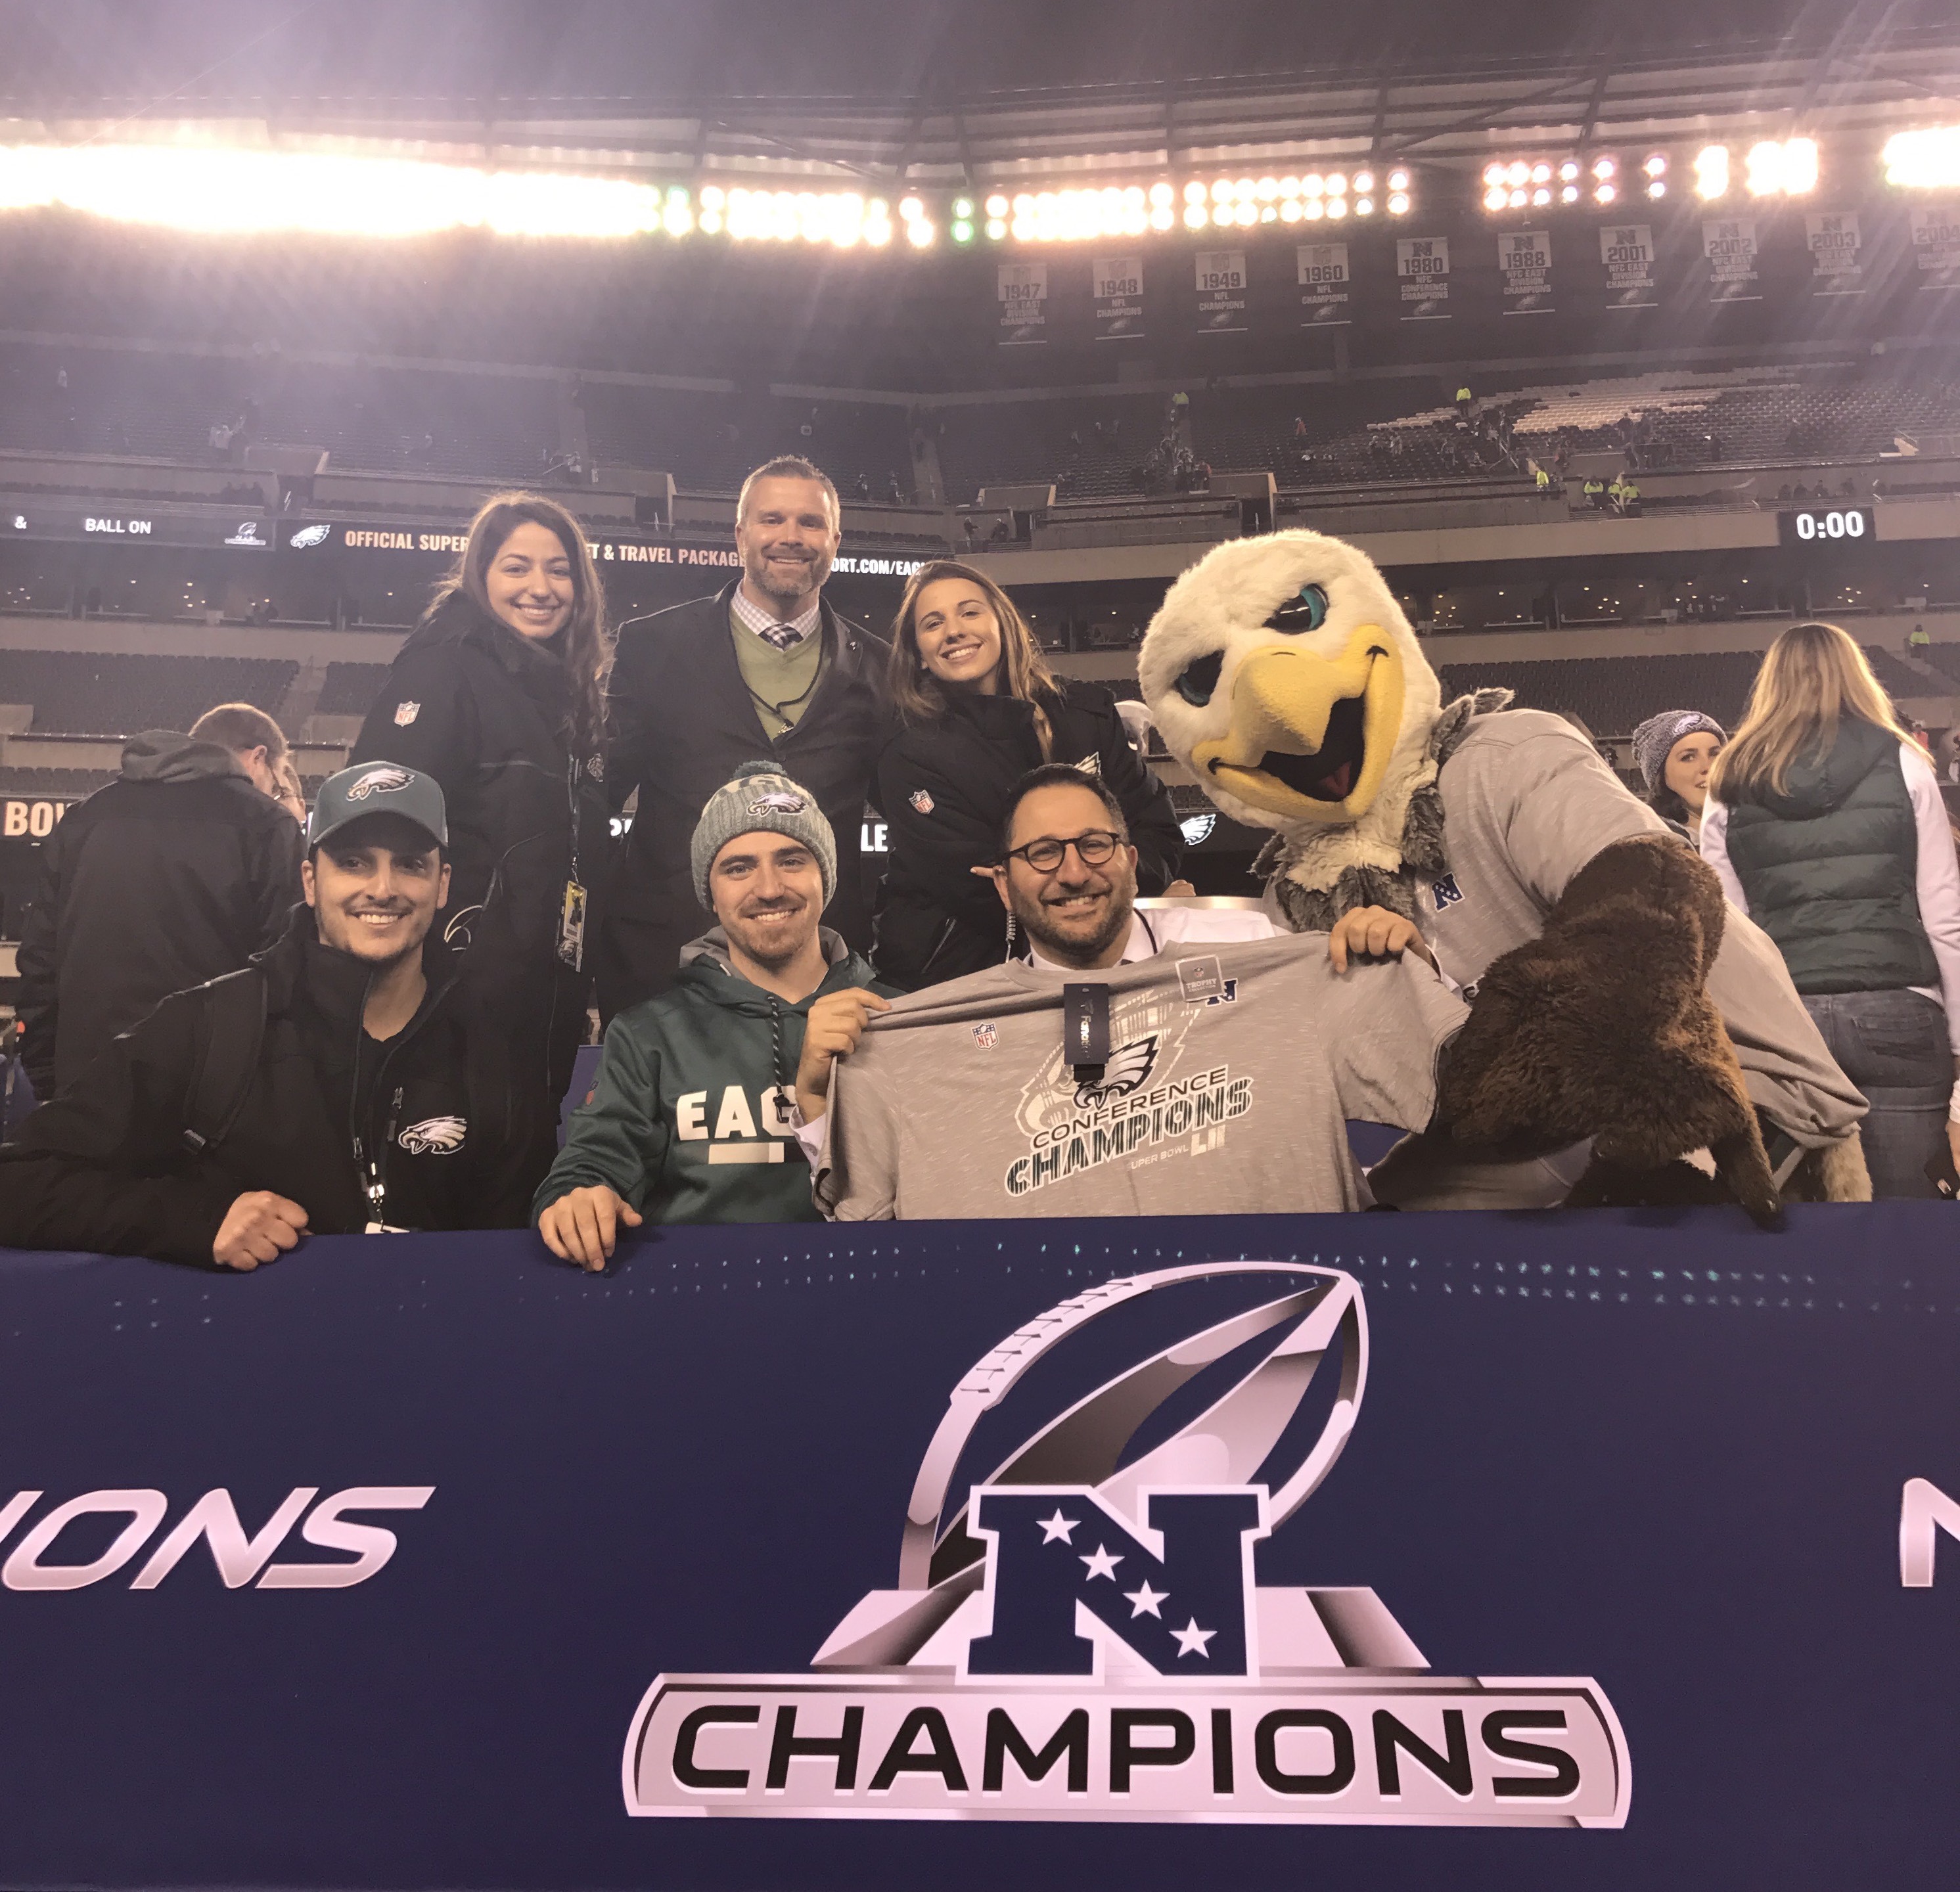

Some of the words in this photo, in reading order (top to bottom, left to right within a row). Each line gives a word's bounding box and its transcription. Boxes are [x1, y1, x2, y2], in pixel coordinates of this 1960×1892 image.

[1709, 238, 1752, 256] 2002
[1812, 231, 1856, 250] 2003
[1505, 251, 1545, 269] 1988
[1607, 245, 1647, 262] 2001
[1304, 265, 1343, 282] 1960
[1403, 258, 1443, 274] 1980
[1609, 263, 1626, 273] NFC
[1628, 262, 1649, 272] EAST
[1099, 279, 1137, 296] 1948
[1202, 271, 1241, 289] 1949
[1607, 279, 1654, 289] CHAMPIONS
[1004, 282, 1041, 300] 1947
[1214, 292, 1229, 300] NFL
[1317, 284, 1333, 294] NFL
[1402, 291, 1448, 301] CHAMPIONS
[1503, 284, 1551, 295] CHAMPIONS
[1112, 298, 1126, 307] NFL
[1199, 300, 1245, 311] CHAMPIONS
[1302, 293, 1348, 304] CHAMPIONS
[1097, 307, 1142, 318] CHAMPIONS
[85, 518, 125, 533] BALL
[129, 521, 151, 534] ON
[1796, 511, 1864, 540] 0:00
[345, 530, 415, 550] OFFICIAL
[419, 534, 470, 552] SUPER
[604, 545, 614, 560] &
[618, 545, 674, 564] TRAVEL
[1186, 978, 1217, 989] TROPHY
[976, 1032, 997, 1047] NFL
[1032, 1066, 1227, 1150] CONFERENCE
[1005, 1076, 1254, 1197] CHAMPIONS
[1128, 1154, 1158, 1169] UPER
[1160, 1144, 1189, 1160] BOWL
[1191, 1124, 1225, 1156] LII
[956, 1484, 1271, 1686] N
[670, 1704, 1582, 1801] CHAMPIONS
